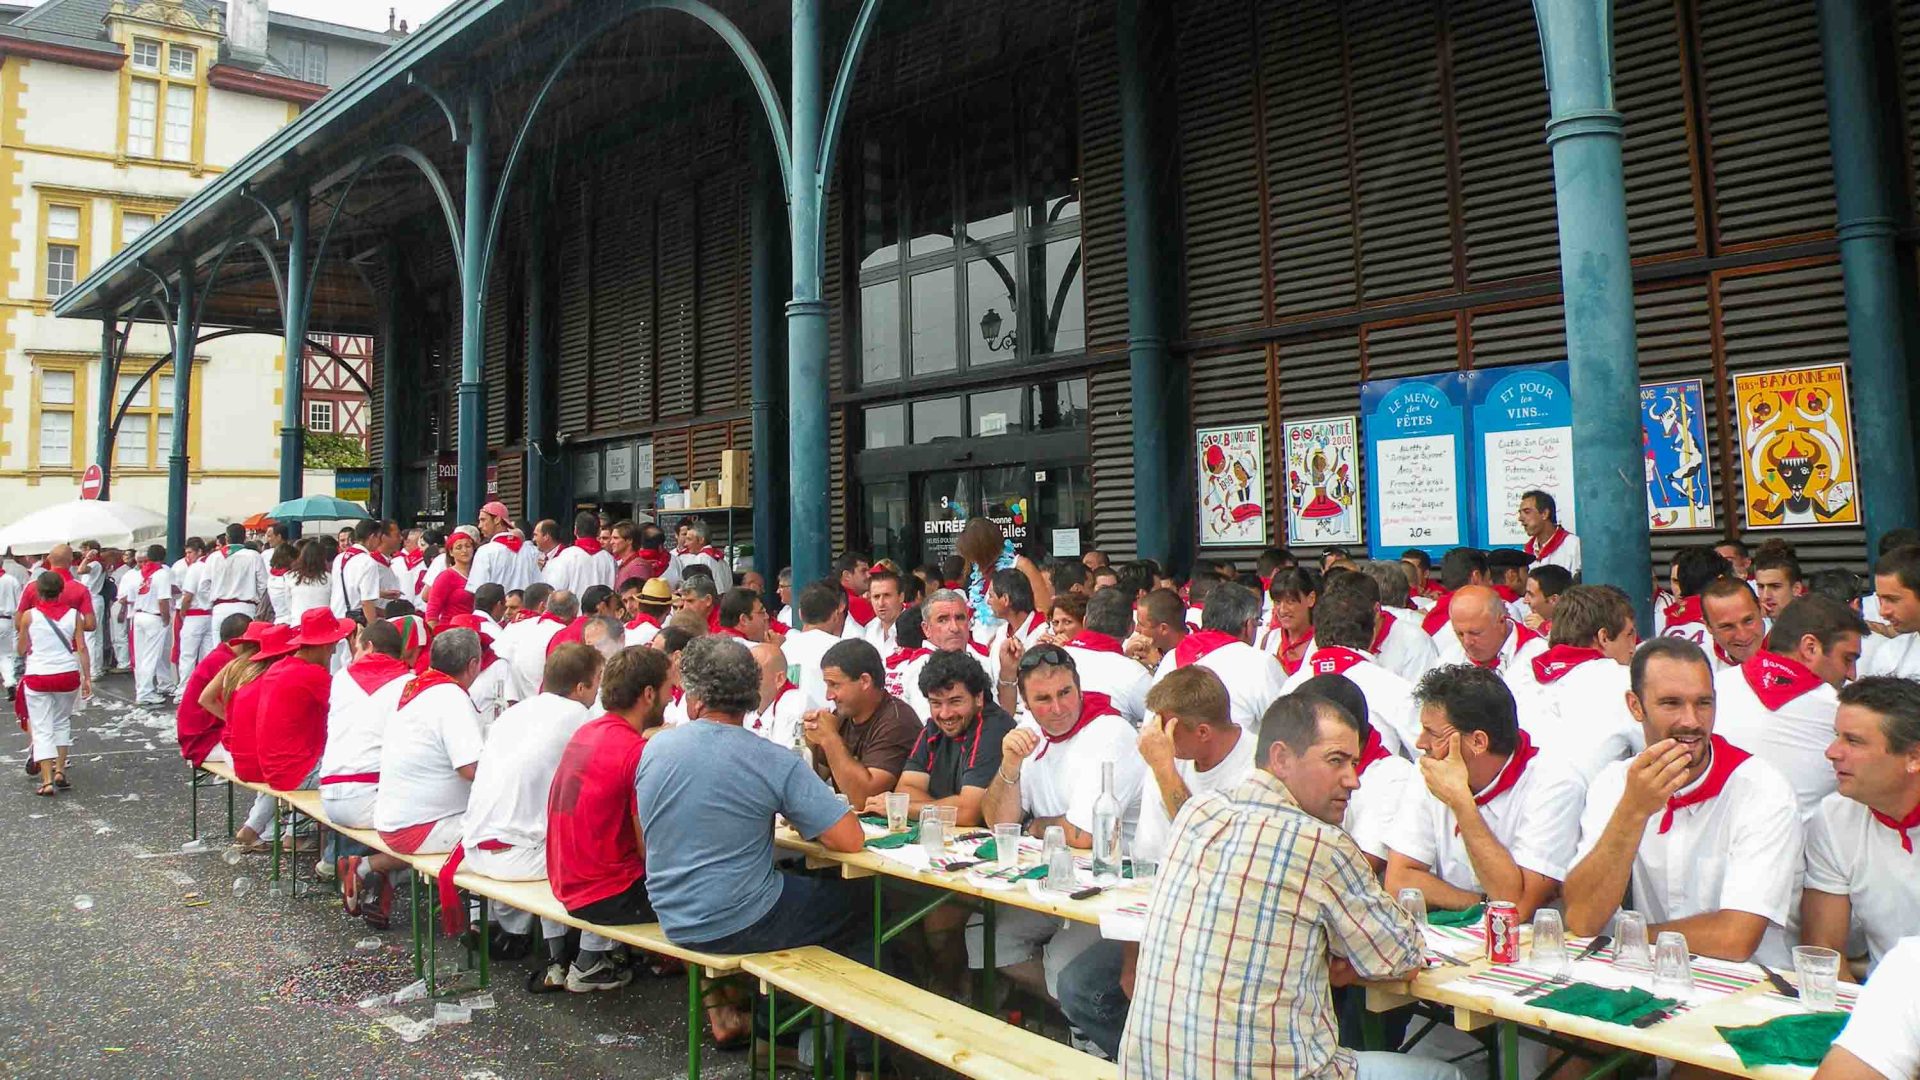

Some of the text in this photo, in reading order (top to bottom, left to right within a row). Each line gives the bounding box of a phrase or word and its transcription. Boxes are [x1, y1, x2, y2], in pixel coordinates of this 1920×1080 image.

[1759, 370, 1826, 389] BAYONNE
[1500, 382, 1554, 404] ET POUR
[1388, 393, 1440, 414] LE MENU
[1406, 405, 1420, 414] des
[1396, 415, 1433, 428] FÊTES
[1332, 436, 1352, 446] 2000
[940, 496, 949, 509] 3
[924, 517, 967, 534] ENTRÉE
[1409, 527, 1432, 539] 20€
